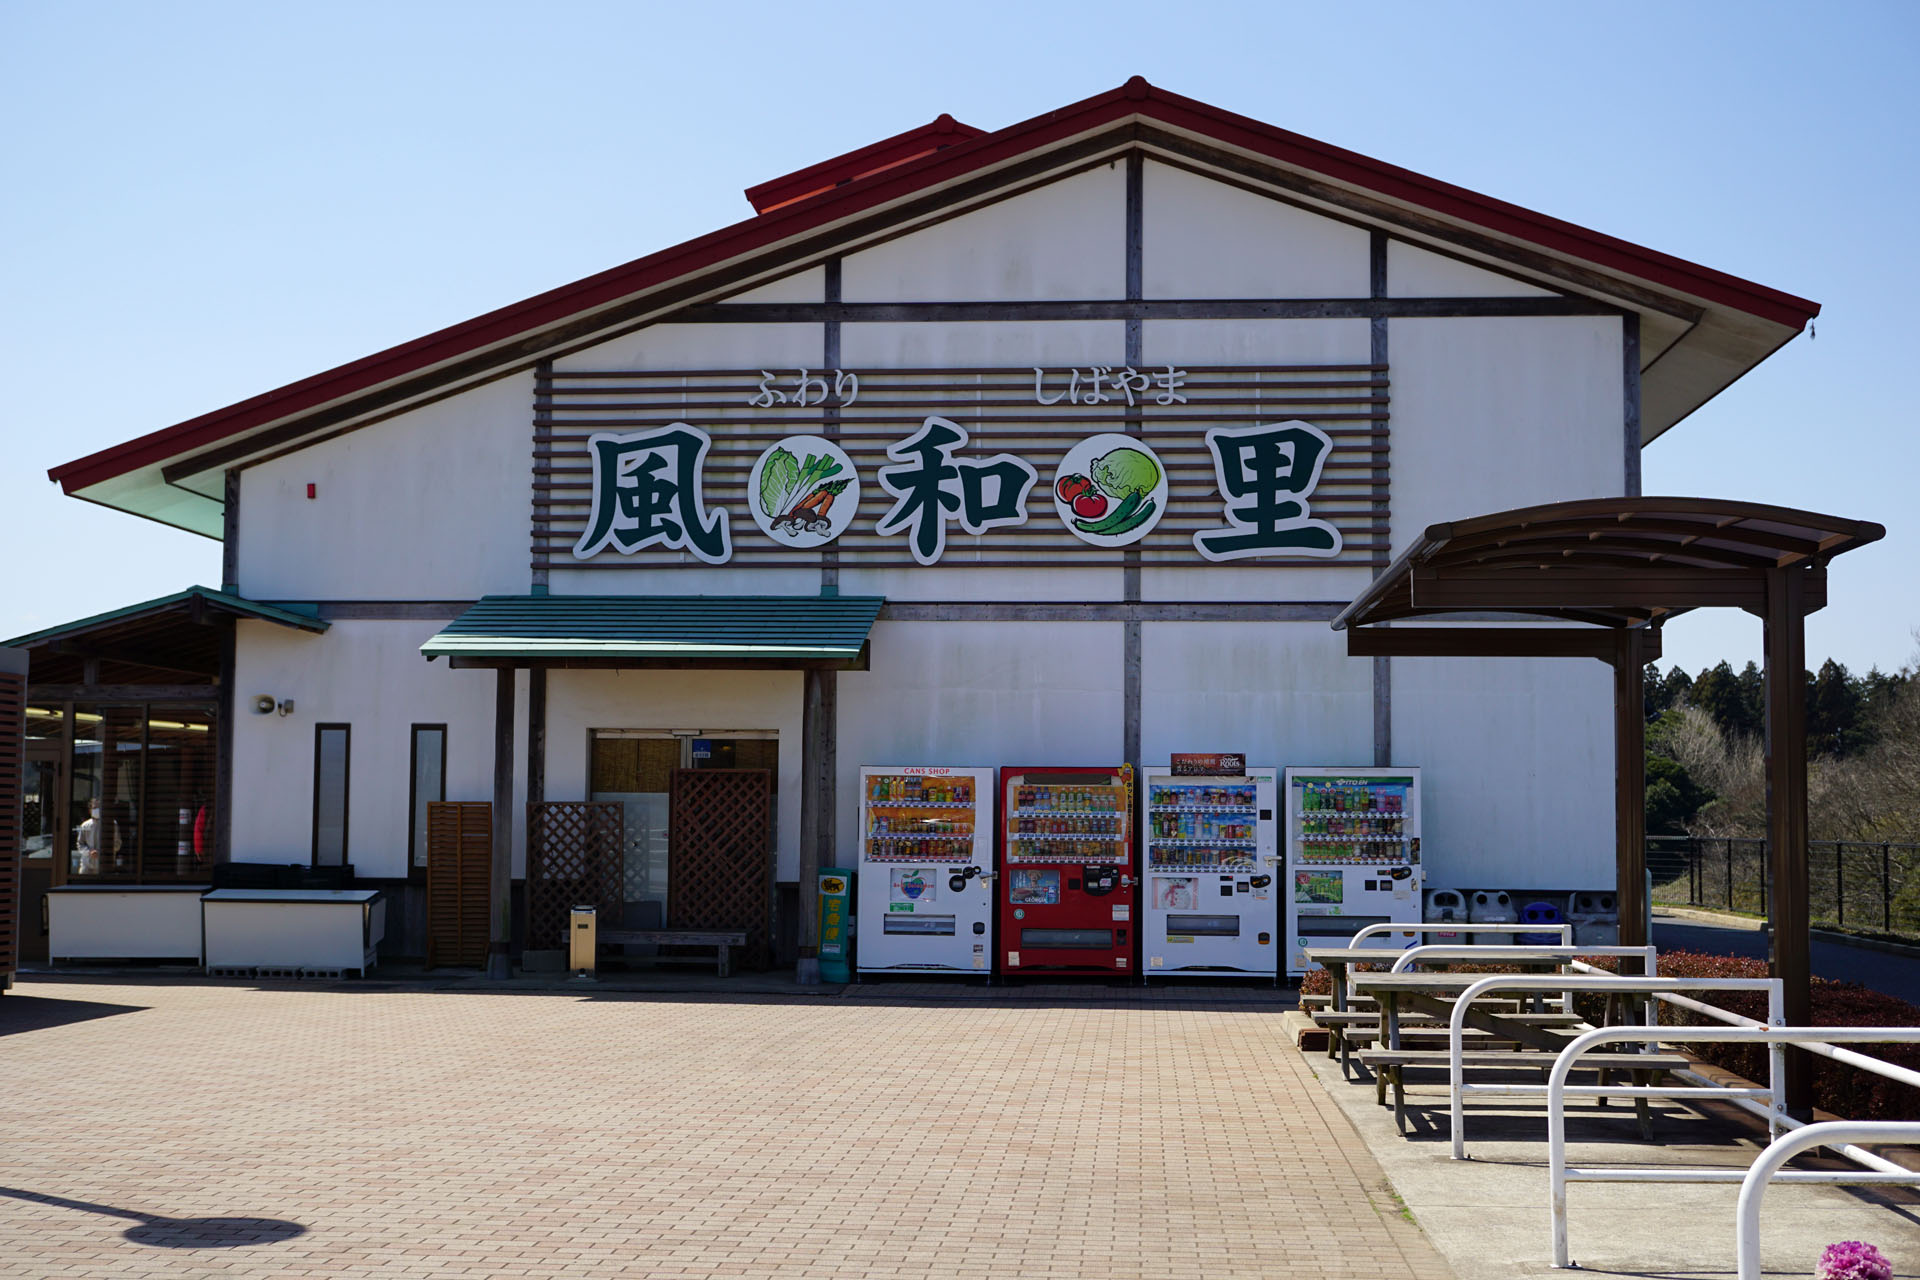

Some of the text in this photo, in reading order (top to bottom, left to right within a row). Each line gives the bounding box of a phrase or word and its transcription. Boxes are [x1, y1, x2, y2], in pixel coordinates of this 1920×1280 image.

[748, 365, 1189, 409] ふわり しばやま
[904, 767, 950, 775] CANS SHOP
[825, 898, 842, 941] 宅急便
